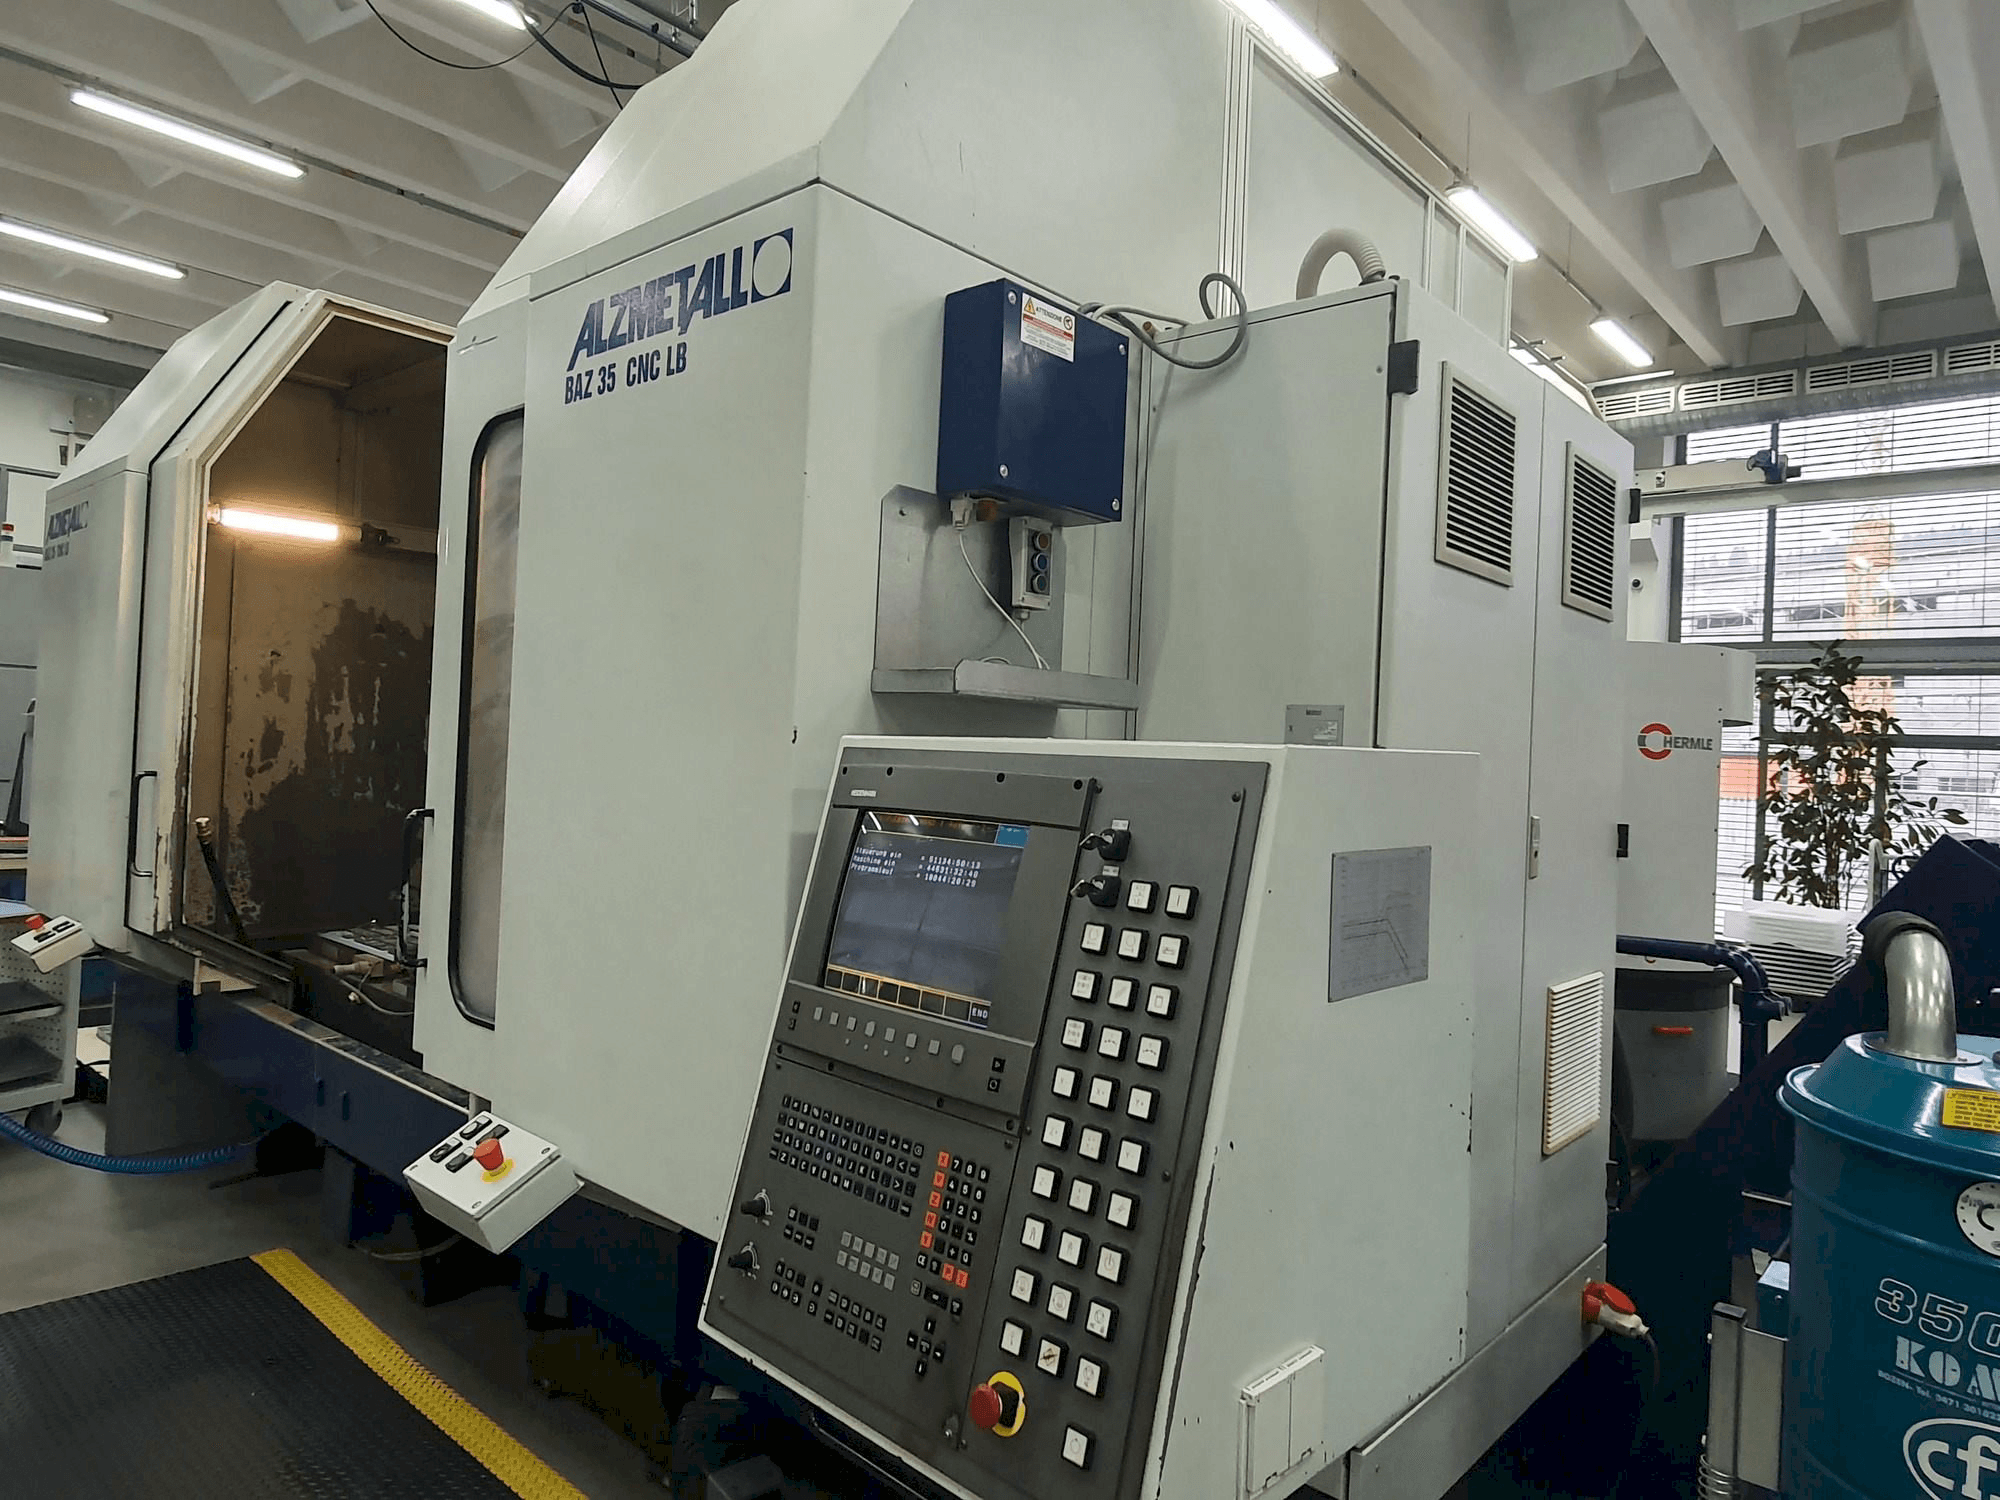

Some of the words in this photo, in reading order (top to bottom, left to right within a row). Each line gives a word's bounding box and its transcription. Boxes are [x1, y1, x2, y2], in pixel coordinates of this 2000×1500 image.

[566, 246, 748, 372] ALZMETALL
[564, 370, 593, 404] BAZ
[597, 363, 616, 395] 35
[626, 350, 661, 387] CNC
[666, 342, 687, 376] LB
[1663, 736, 1713, 751] HERMLE
[971, 1007, 989, 1019] END
[953, 1159, 960, 1170] 7
[966, 1164, 973, 1174] 8
[980, 1169, 987, 1180] 9
[949, 1180, 955, 1190] 4
[962, 1184, 968, 1195] 5
[976, 1189, 982, 1200] 6
[946, 1200, 950, 1210] 1
[958, 1205, 964, 1216] 2
[971, 1210, 978, 1221] 3
[940, 1220, 947, 1231] 0
